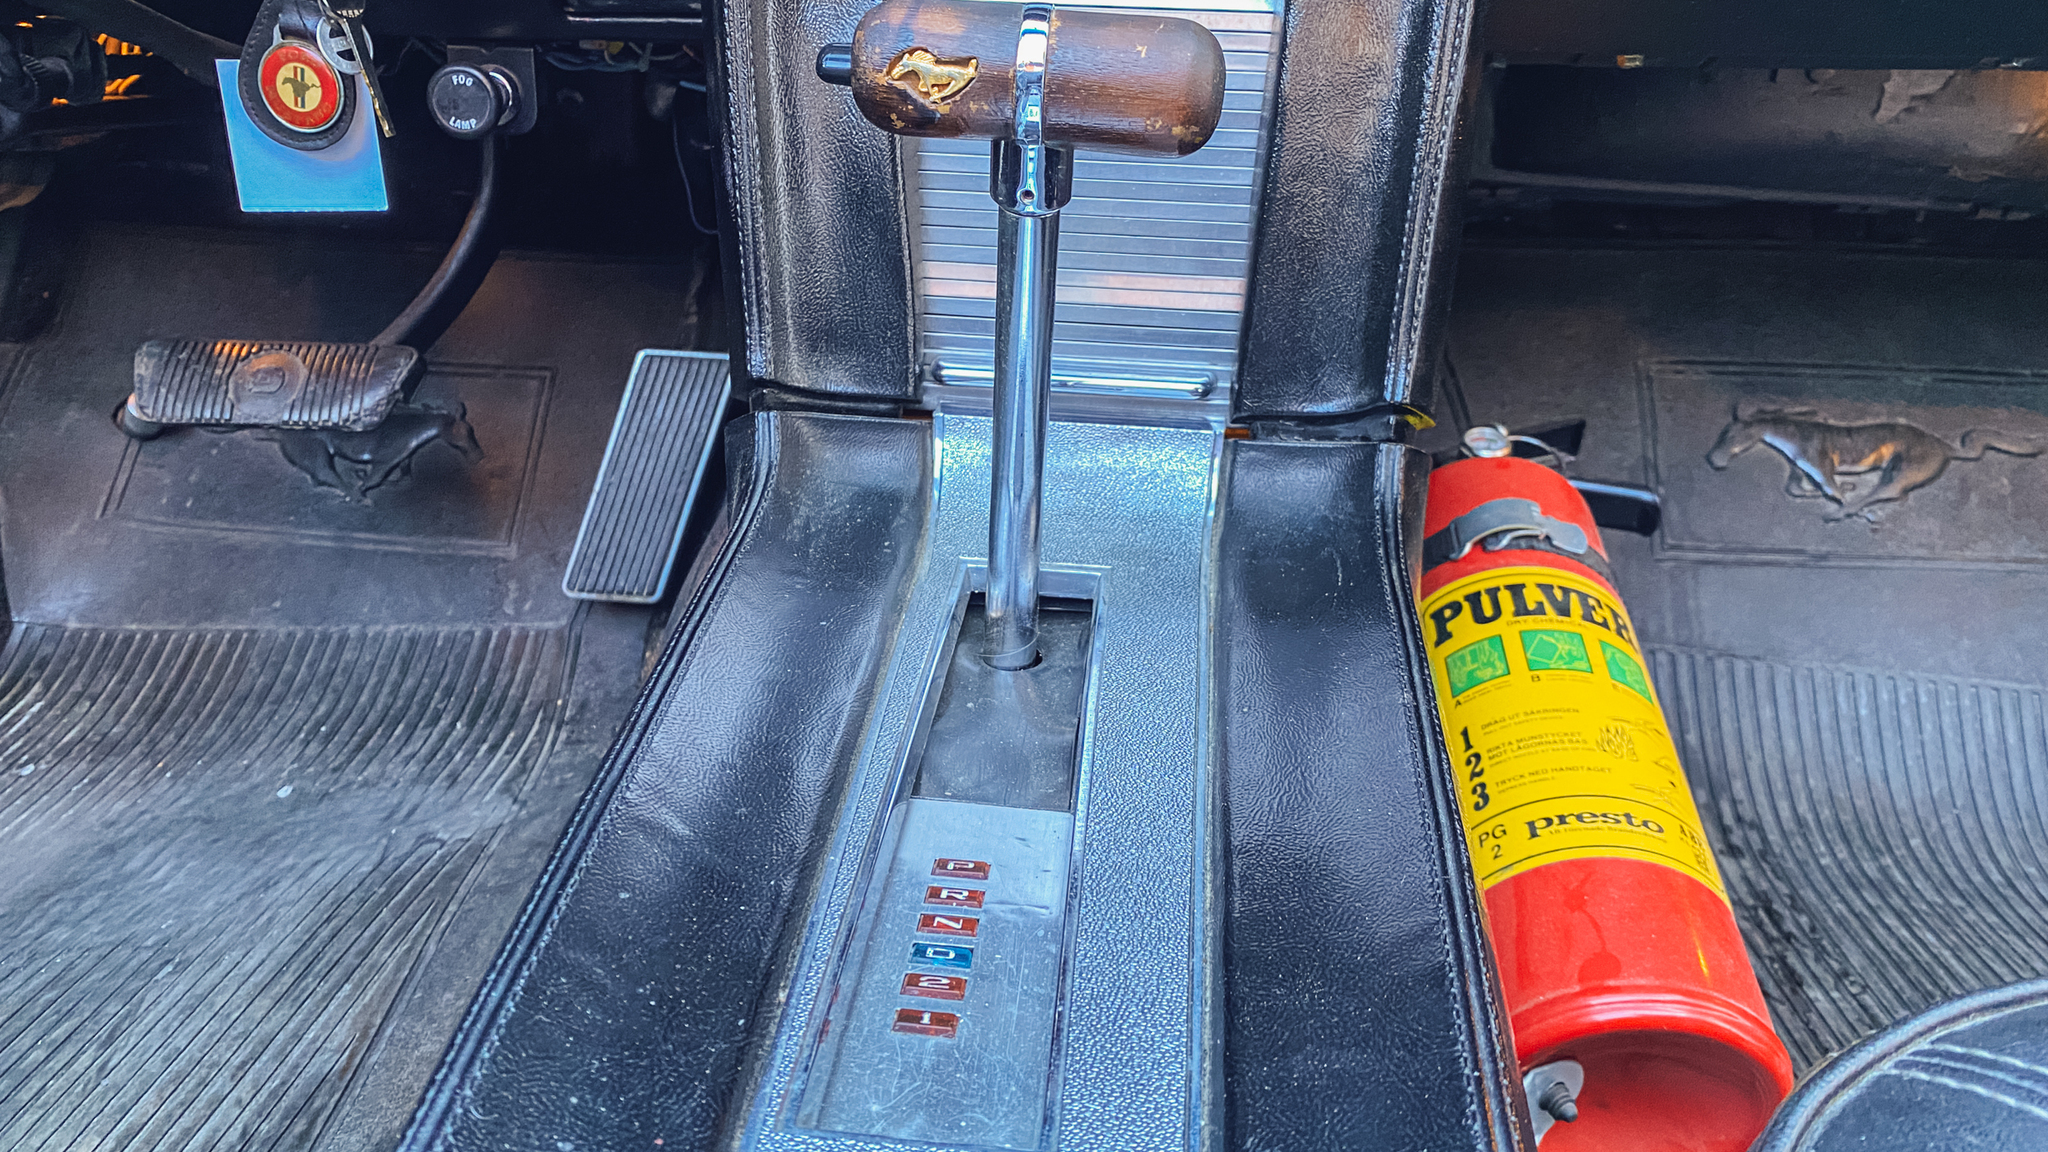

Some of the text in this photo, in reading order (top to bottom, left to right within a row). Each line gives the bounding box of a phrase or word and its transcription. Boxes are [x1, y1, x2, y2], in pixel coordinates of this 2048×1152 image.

[451, 74, 474, 87] FOG
[448, 116, 477, 130] LAMP
[1429, 582, 1640, 651] PULVER
[1531, 673, 1541, 683] B
[1454, 699, 1463, 710] A
[1508, 712, 1521, 722] UT
[1459, 726, 1474, 752] 1
[1488, 749, 1508, 761] MOT
[1464, 752, 1485, 782] 2
[1495, 773, 1527, 788] TRYCK
[1528, 768, 1549, 777] NED
[1471, 782, 1490, 811] 3
[1524, 810, 1665, 841] presto
[1478, 824, 1508, 848] PG
[1491, 844, 1504, 860] 2
[946, 860, 976, 870] P
[939, 888, 970, 901] R
[932, 916, 964, 930] N
[925, 947, 956, 960] D
[918, 976, 951, 989] 2
[920, 1012, 932, 1025] 1
